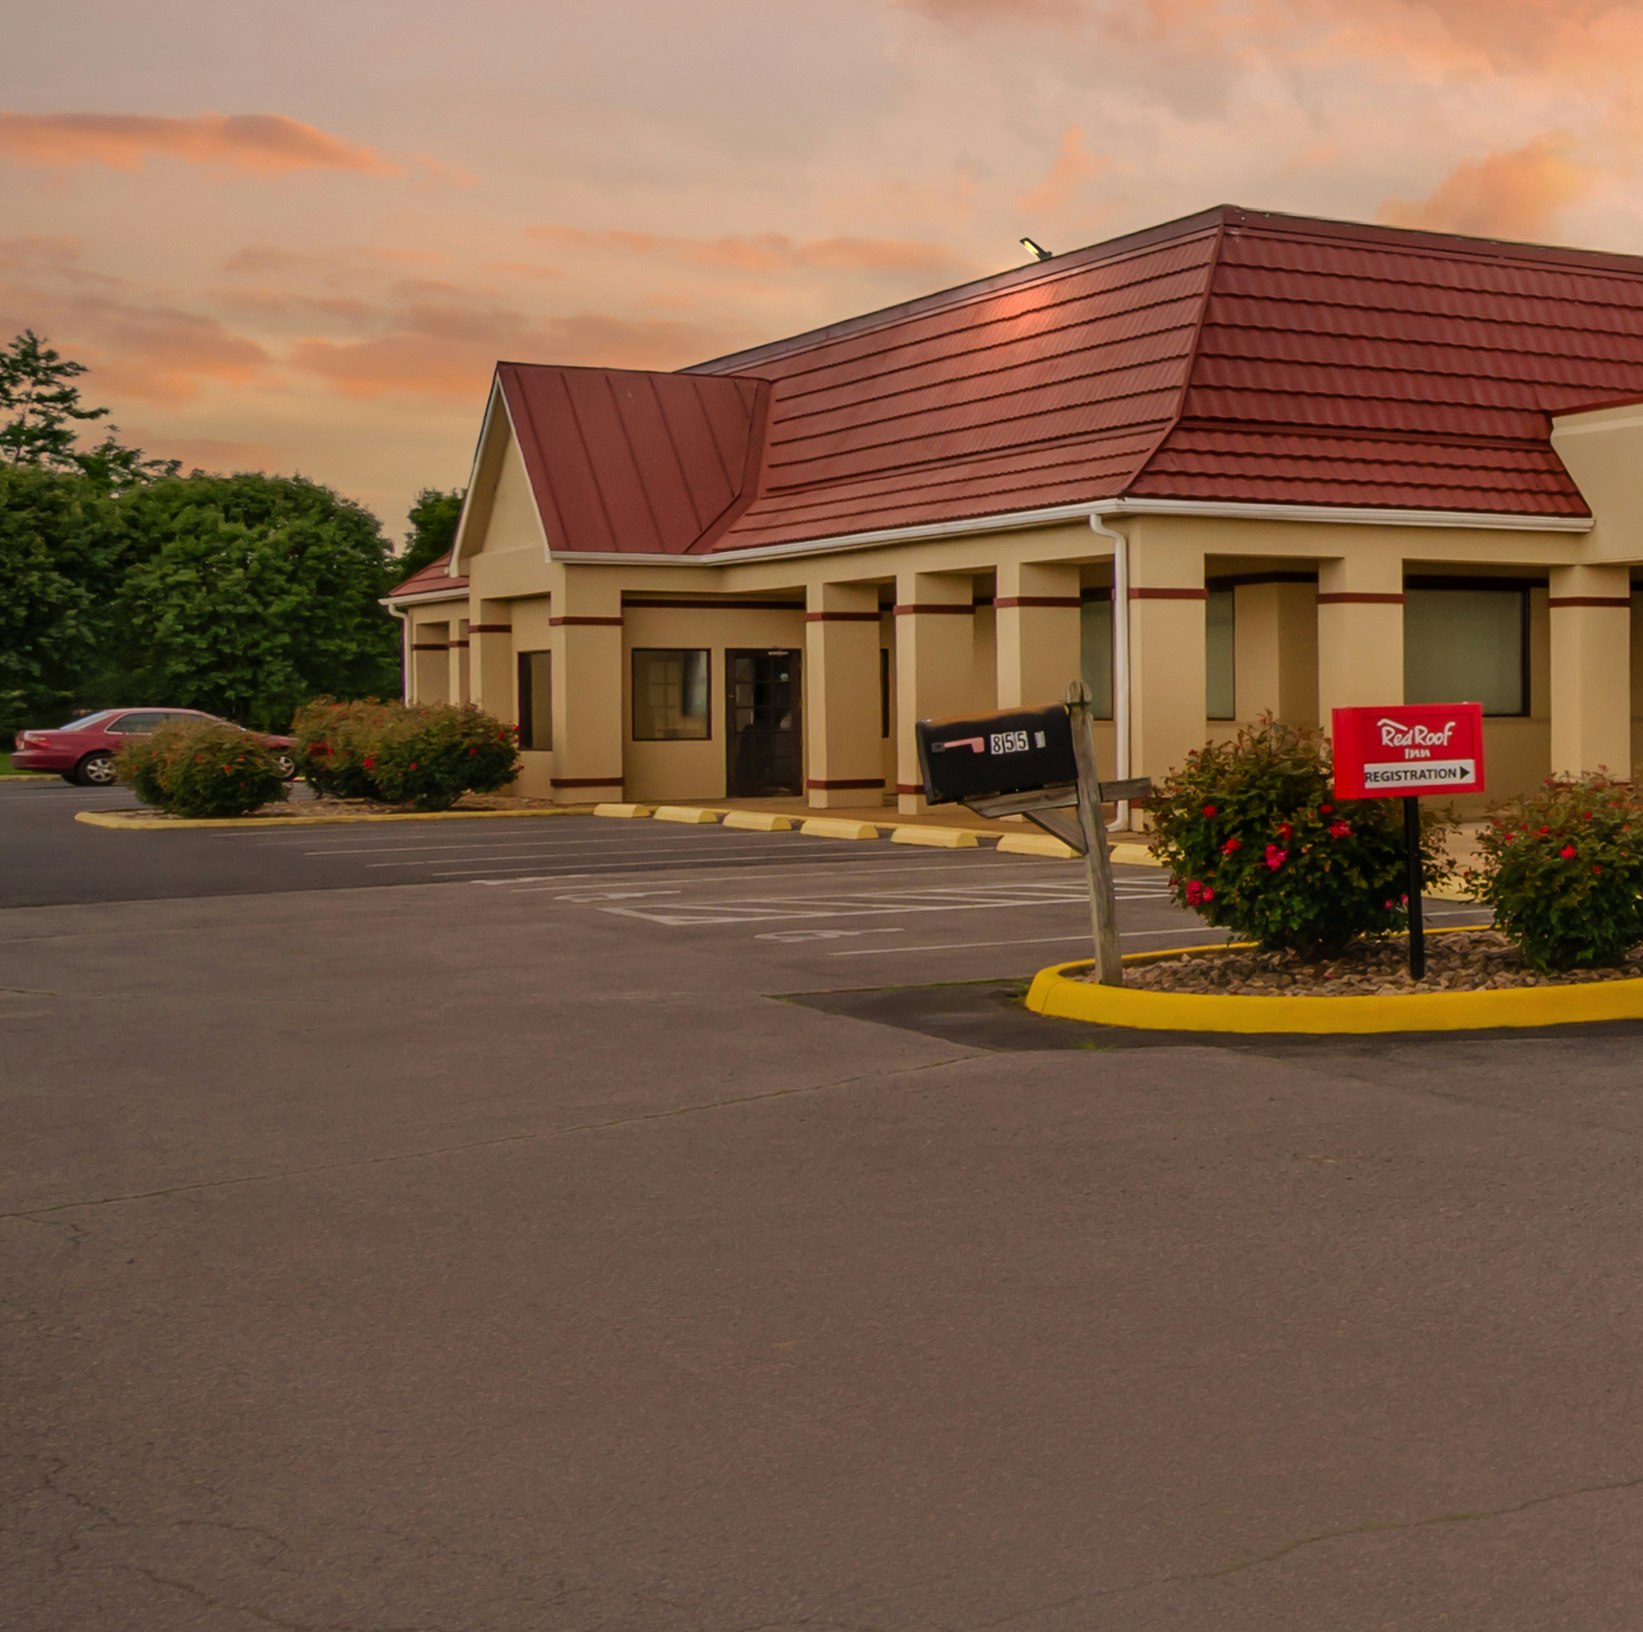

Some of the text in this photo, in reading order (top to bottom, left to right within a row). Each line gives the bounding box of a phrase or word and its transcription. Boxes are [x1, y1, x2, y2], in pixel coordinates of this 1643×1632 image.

[1381, 721, 1456, 747] Red Roof
[1364, 768, 1457, 783] REGISTRATION
